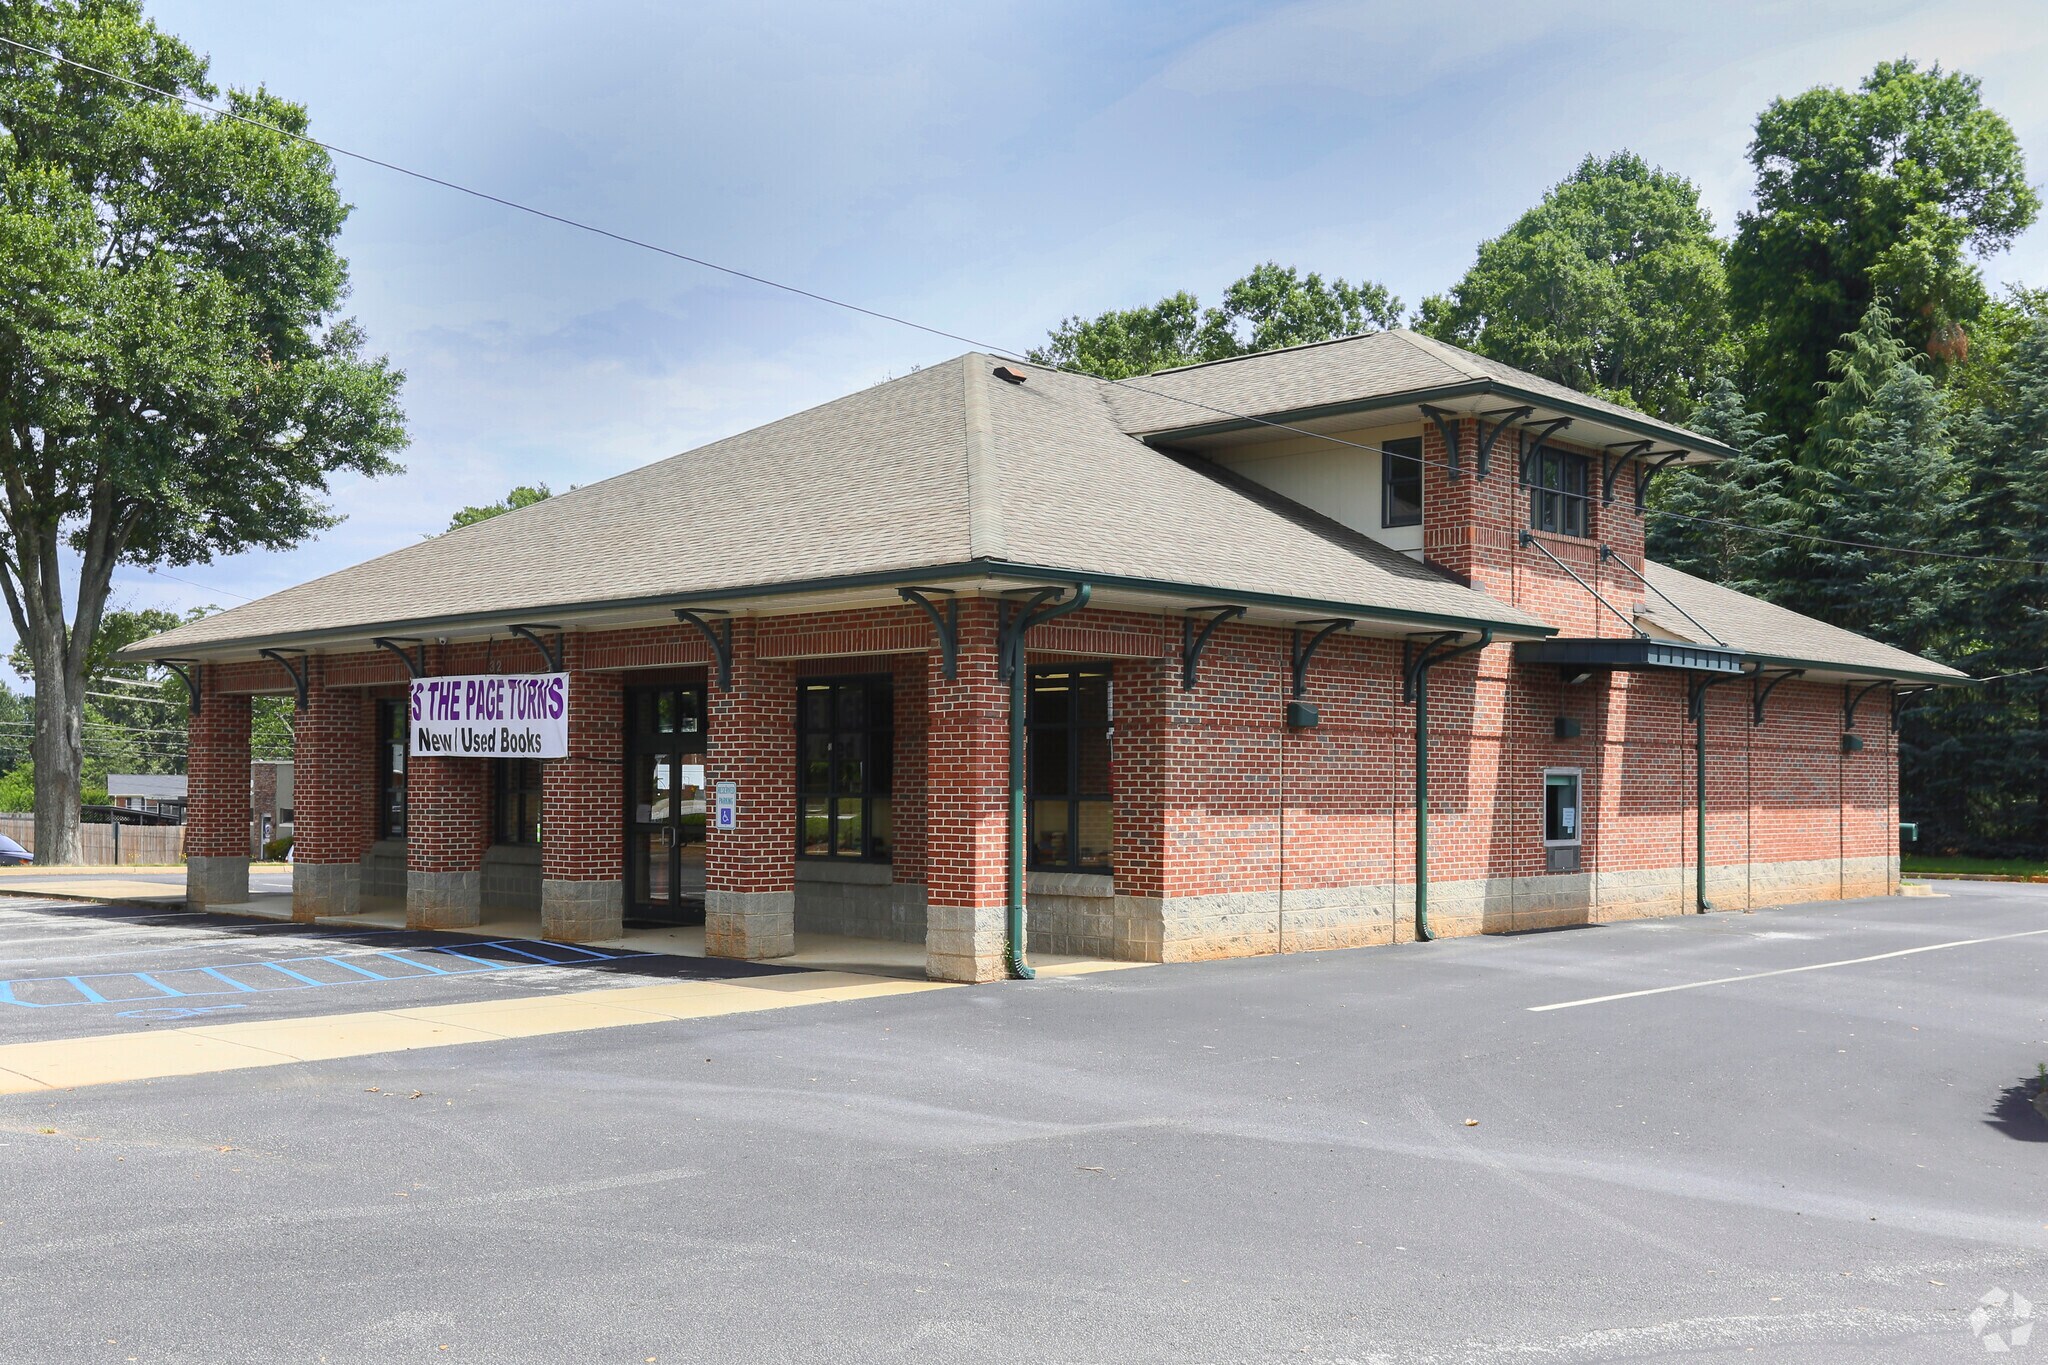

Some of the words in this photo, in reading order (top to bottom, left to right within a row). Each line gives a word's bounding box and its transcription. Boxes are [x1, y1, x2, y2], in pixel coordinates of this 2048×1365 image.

[410, 682, 424, 721] S
[428, 681, 462, 721] THE
[466, 679, 504, 721] PAGE
[508, 677, 564, 721] TURNS
[418, 727, 452, 752] New
[461, 727, 496, 753] Used
[500, 727, 542, 753] Books
